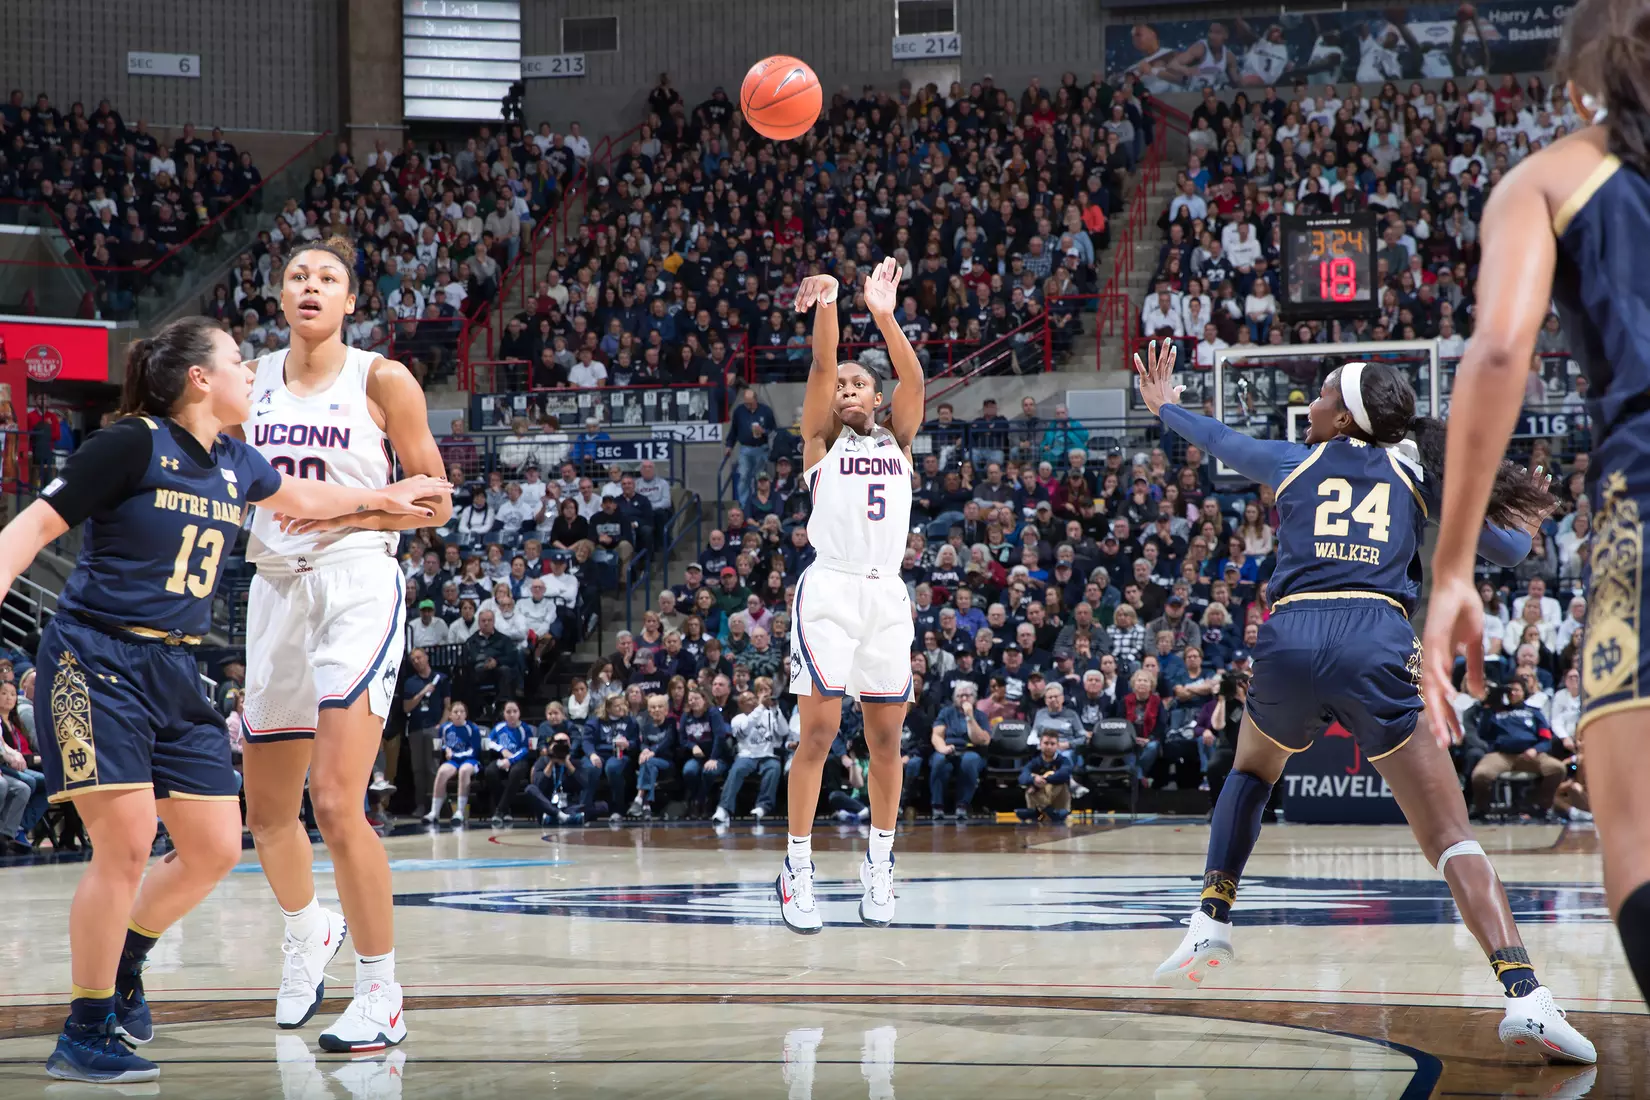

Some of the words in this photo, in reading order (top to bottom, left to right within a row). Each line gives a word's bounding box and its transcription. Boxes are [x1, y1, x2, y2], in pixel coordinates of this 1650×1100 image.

[1488, 9, 1529, 24] Harry
[1533, 7, 1550, 20] A.
[894, 42, 916, 53] SEC
[925, 37, 959, 54] 214
[130, 58, 153, 69] SEC
[179, 58, 190, 73] 6
[552, 57, 583, 73] 213
[1312, 229, 1363, 256] 3:24
[1320, 257, 1356, 303] 18
[28, 363, 57, 373] HELP
[685, 425, 720, 441] 214
[1527, 415, 1568, 435] 116
[254, 423, 351, 450] UCONN
[597, 447, 622, 458] SEC
[634, 442, 669, 460] 113
[840, 457, 903, 475] UCONN
[154, 488, 209, 518] NOTRE
[211, 500, 242, 527] DAME
[867, 484, 886, 521] 5
[1314, 477, 1391, 543] 24
[165, 524, 225, 599] 13
[1314, 542, 1380, 566] WALKER
[999, 723, 1025, 731] UCONN
[1100, 722, 1127, 730] UCONN
